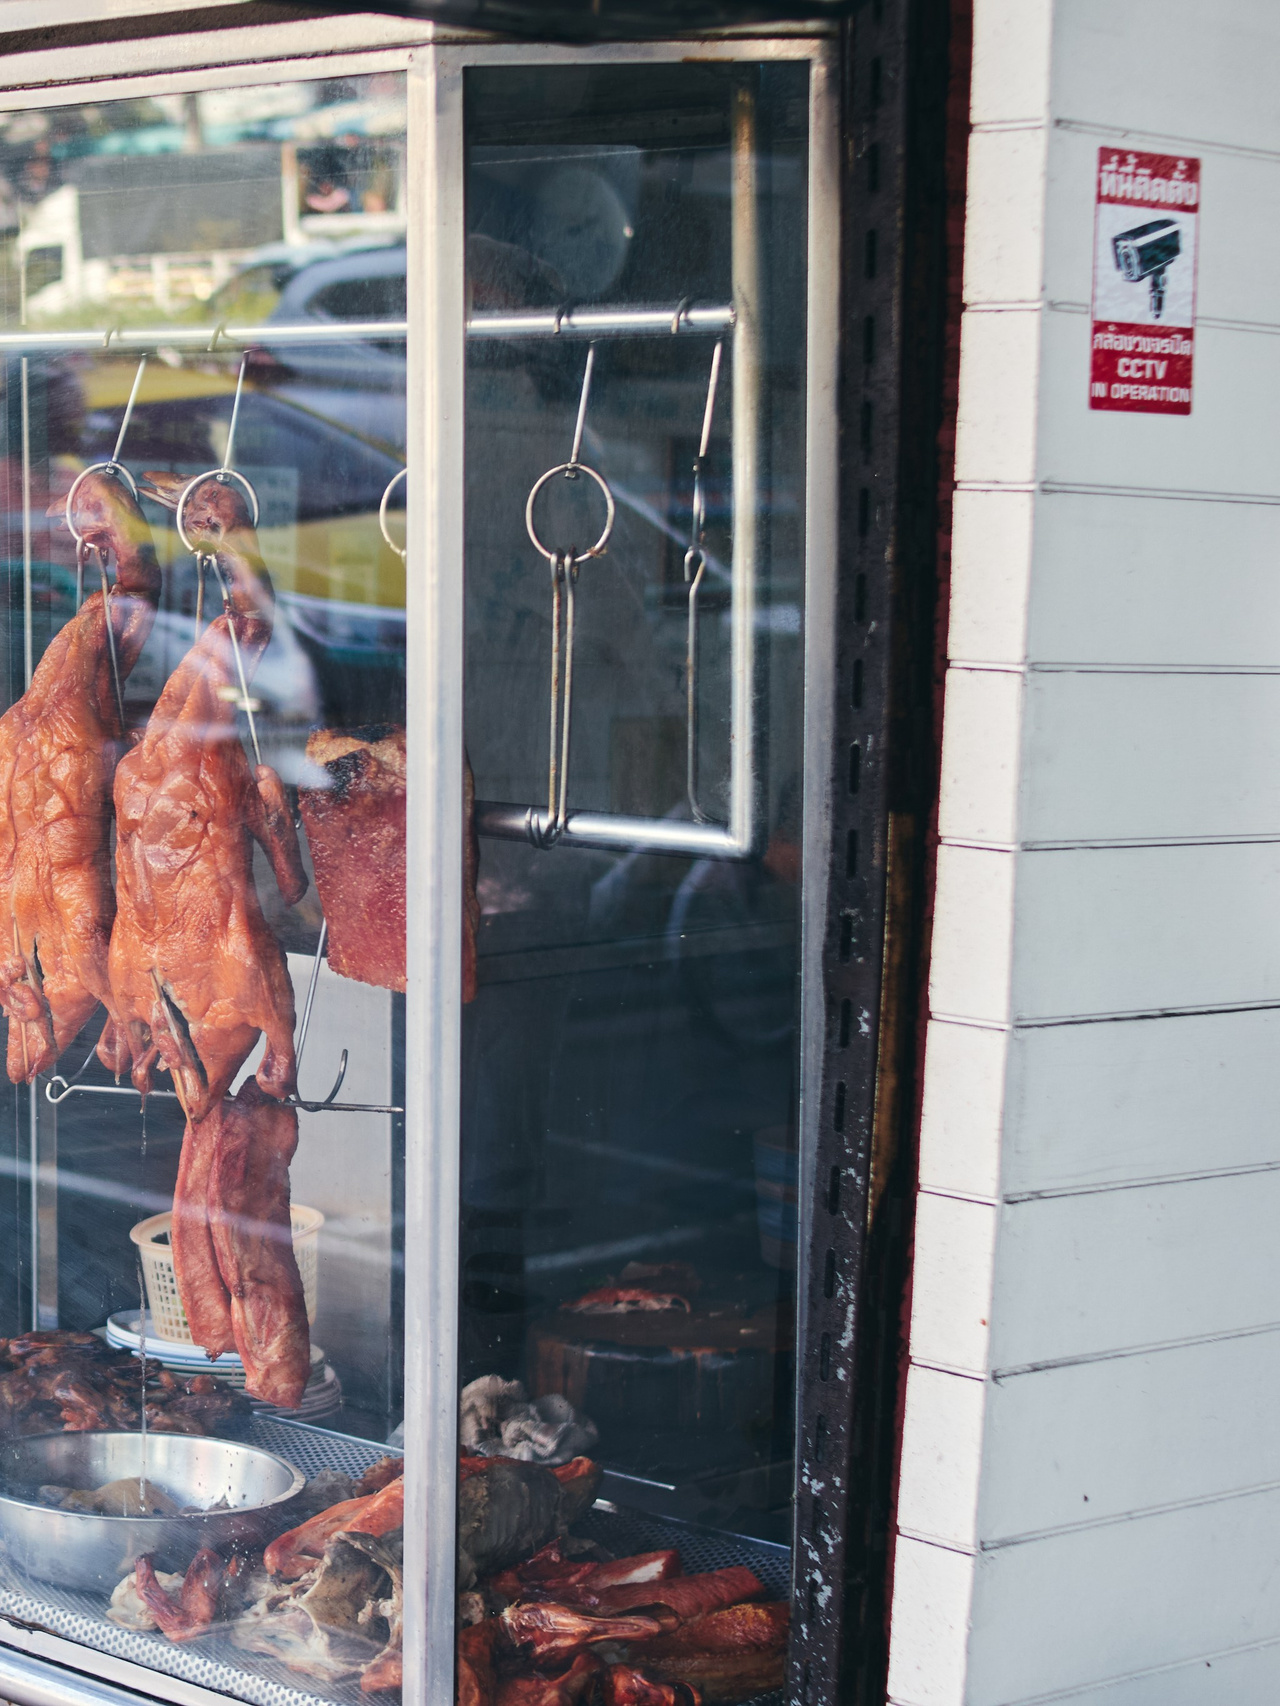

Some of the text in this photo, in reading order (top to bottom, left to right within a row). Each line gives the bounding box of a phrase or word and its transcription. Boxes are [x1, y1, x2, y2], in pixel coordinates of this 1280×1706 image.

[1093, 324, 1191, 355] กล้องวงจรปิด
[1117, 357, 1168, 380] CCTV
[1091, 382, 1192, 402] IN OPERATION
